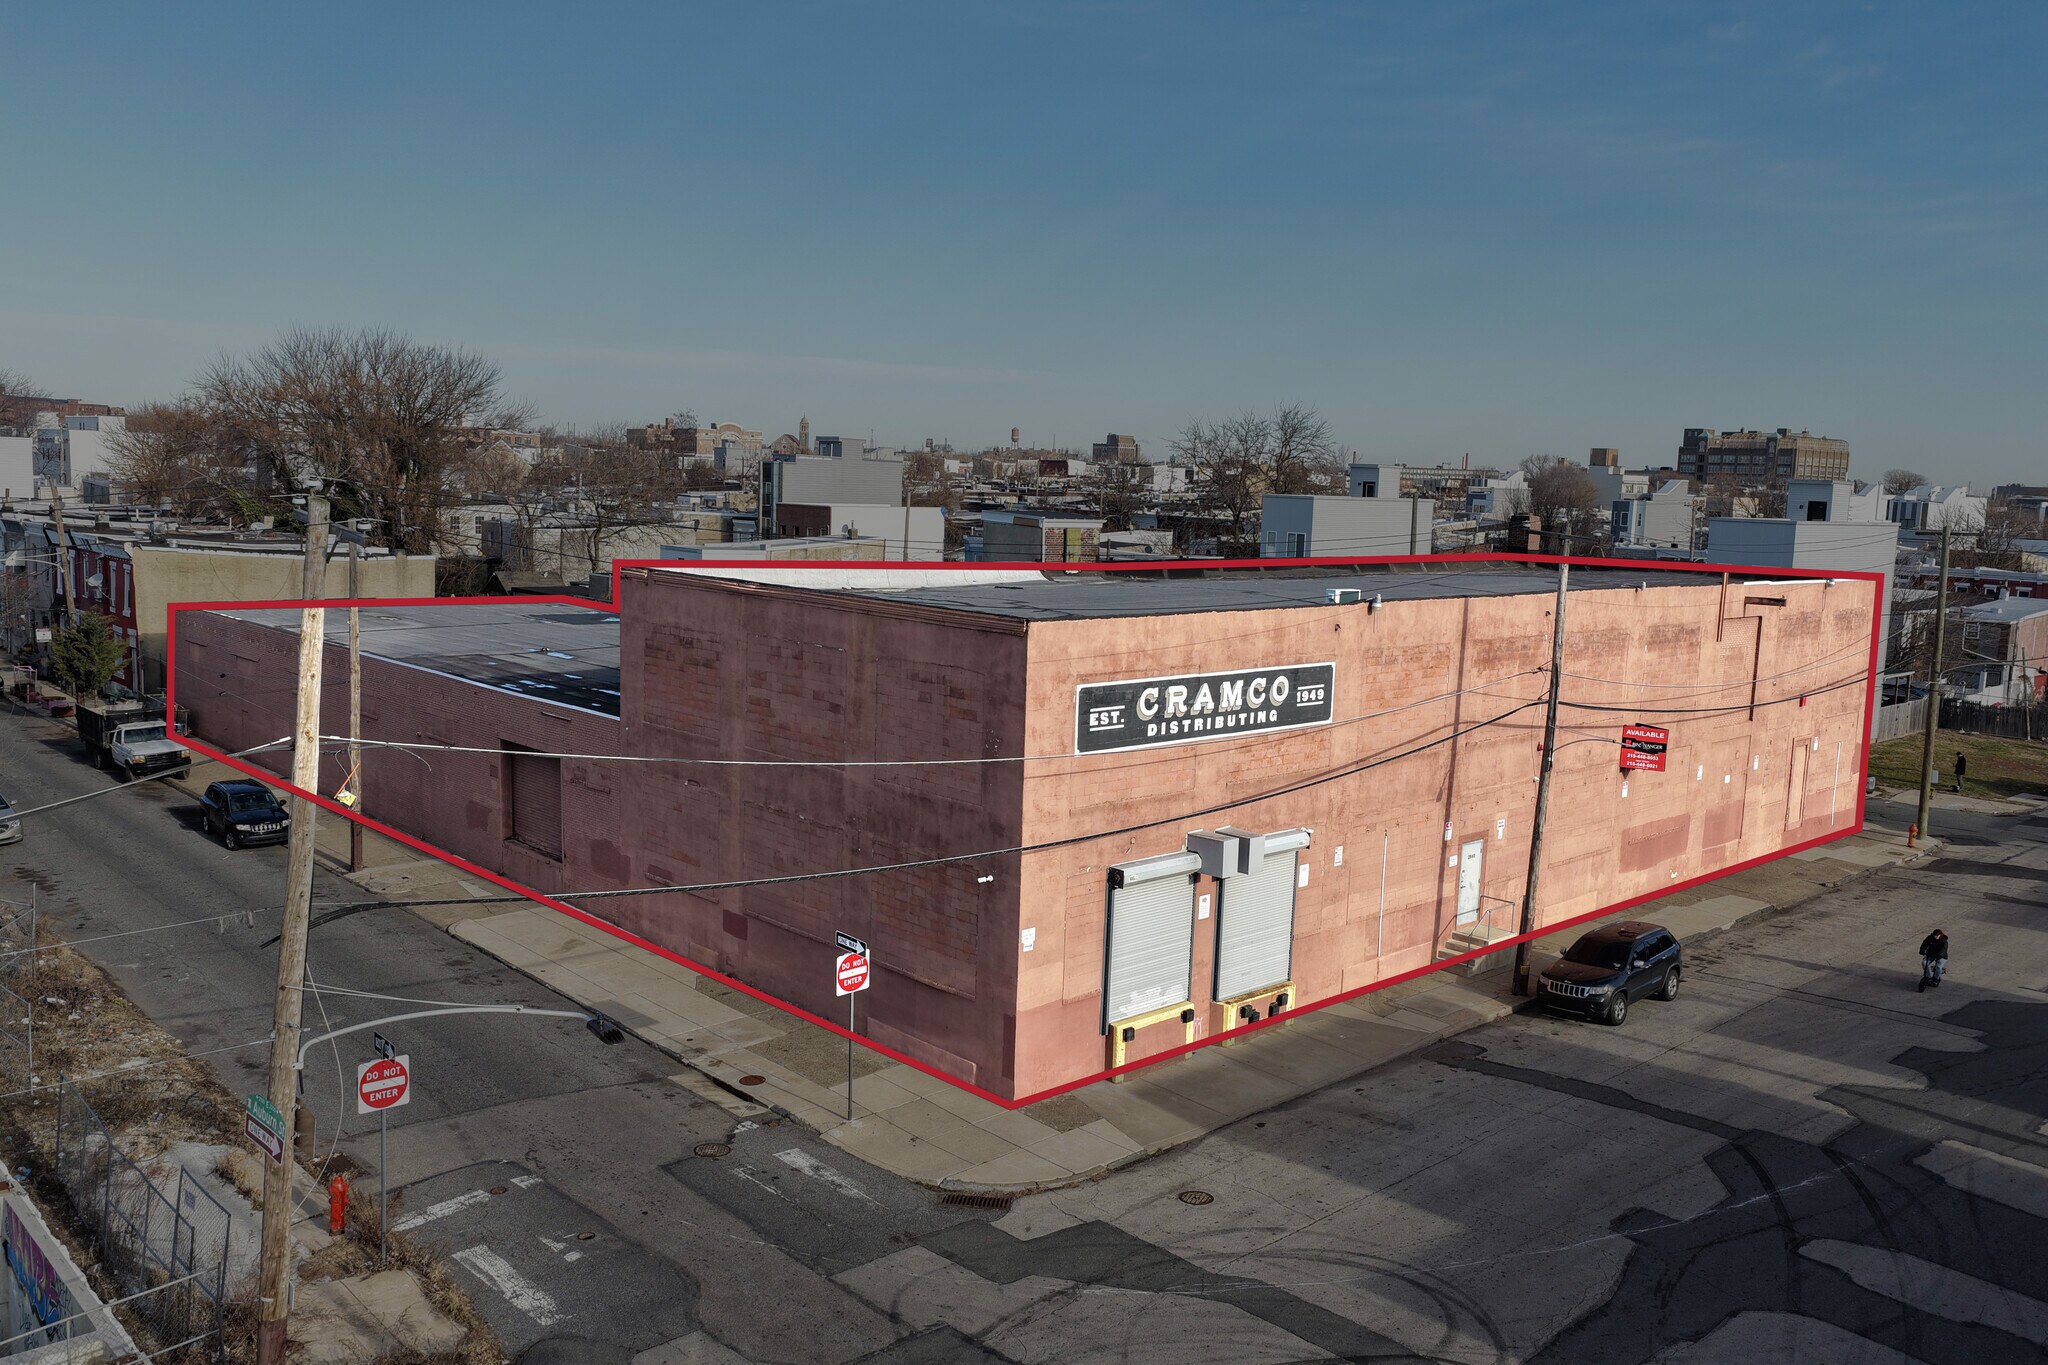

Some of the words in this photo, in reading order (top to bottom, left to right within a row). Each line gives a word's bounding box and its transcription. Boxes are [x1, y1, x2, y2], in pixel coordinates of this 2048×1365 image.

[1136, 675, 1290, 721] CRAMCO
[1296, 688, 1325, 702] 1949
[1089, 711, 1125, 726] EST.
[1147, 709, 1278, 737] DISTRIBUTING
[1626, 729, 1665, 739] AVAILABLE
[841, 962, 850, 971] DO
[852, 958, 864, 968] NOT
[843, 976, 863, 987] ENTER
[366, 1071, 379, 1081] DO
[383, 1066, 401, 1078] NOT
[369, 1088, 399, 1102] ENTER
[252, 1101, 277, 1130] Auburn
[278, 1121, 285, 1137] St
[250, 1122, 261, 1138] ONE
[262, 1133, 274, 1147] WAY
